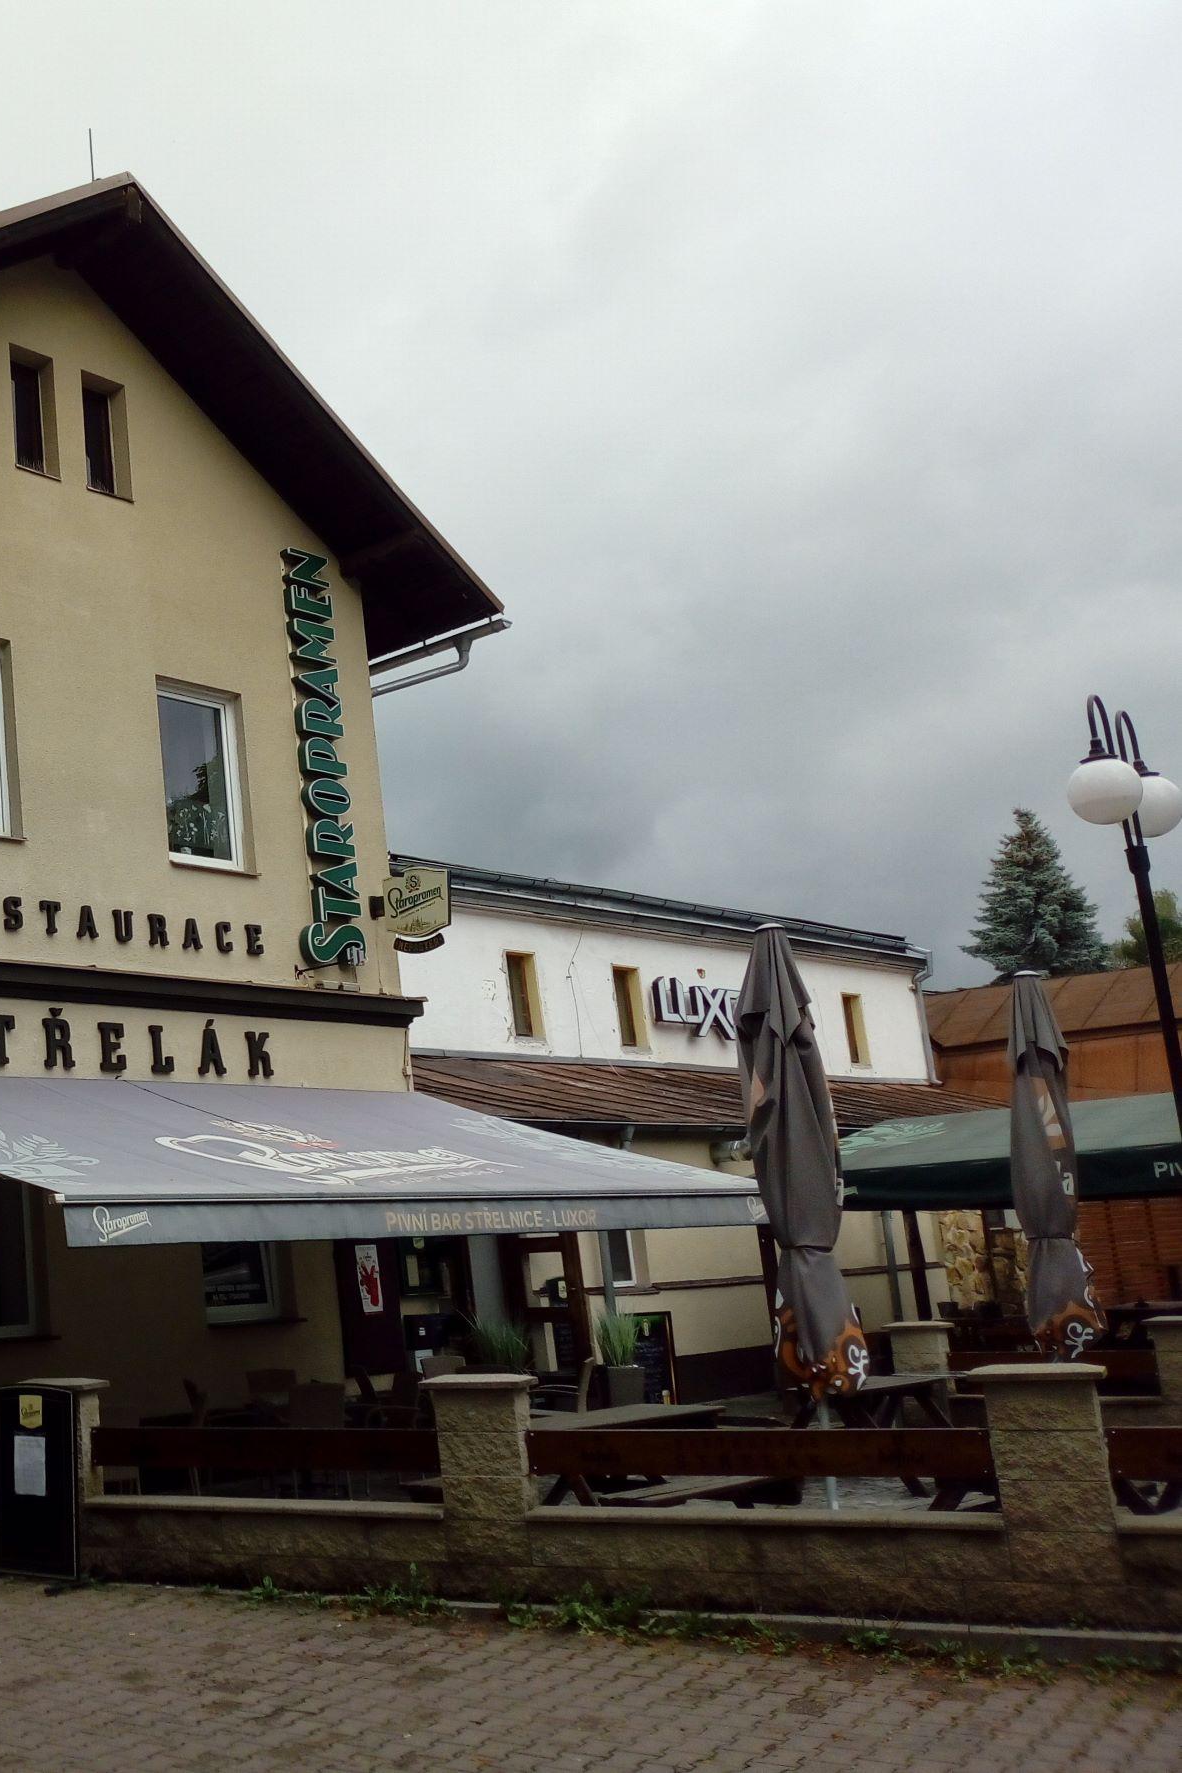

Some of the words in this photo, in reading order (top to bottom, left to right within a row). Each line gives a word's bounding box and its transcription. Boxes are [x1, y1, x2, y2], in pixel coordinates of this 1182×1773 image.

[280, 546, 368, 966] STAROPRAMEN
[387, 886, 443, 919] Staropramen
[92, 1206, 152, 1242] Staropramen
[386, 1207, 427, 1233] PIVNÍ
[431, 1211, 461, 1231] BAR
[465, 1207, 543, 1230] STŘELNICE
[552, 1208, 597, 1227] LUXOR
